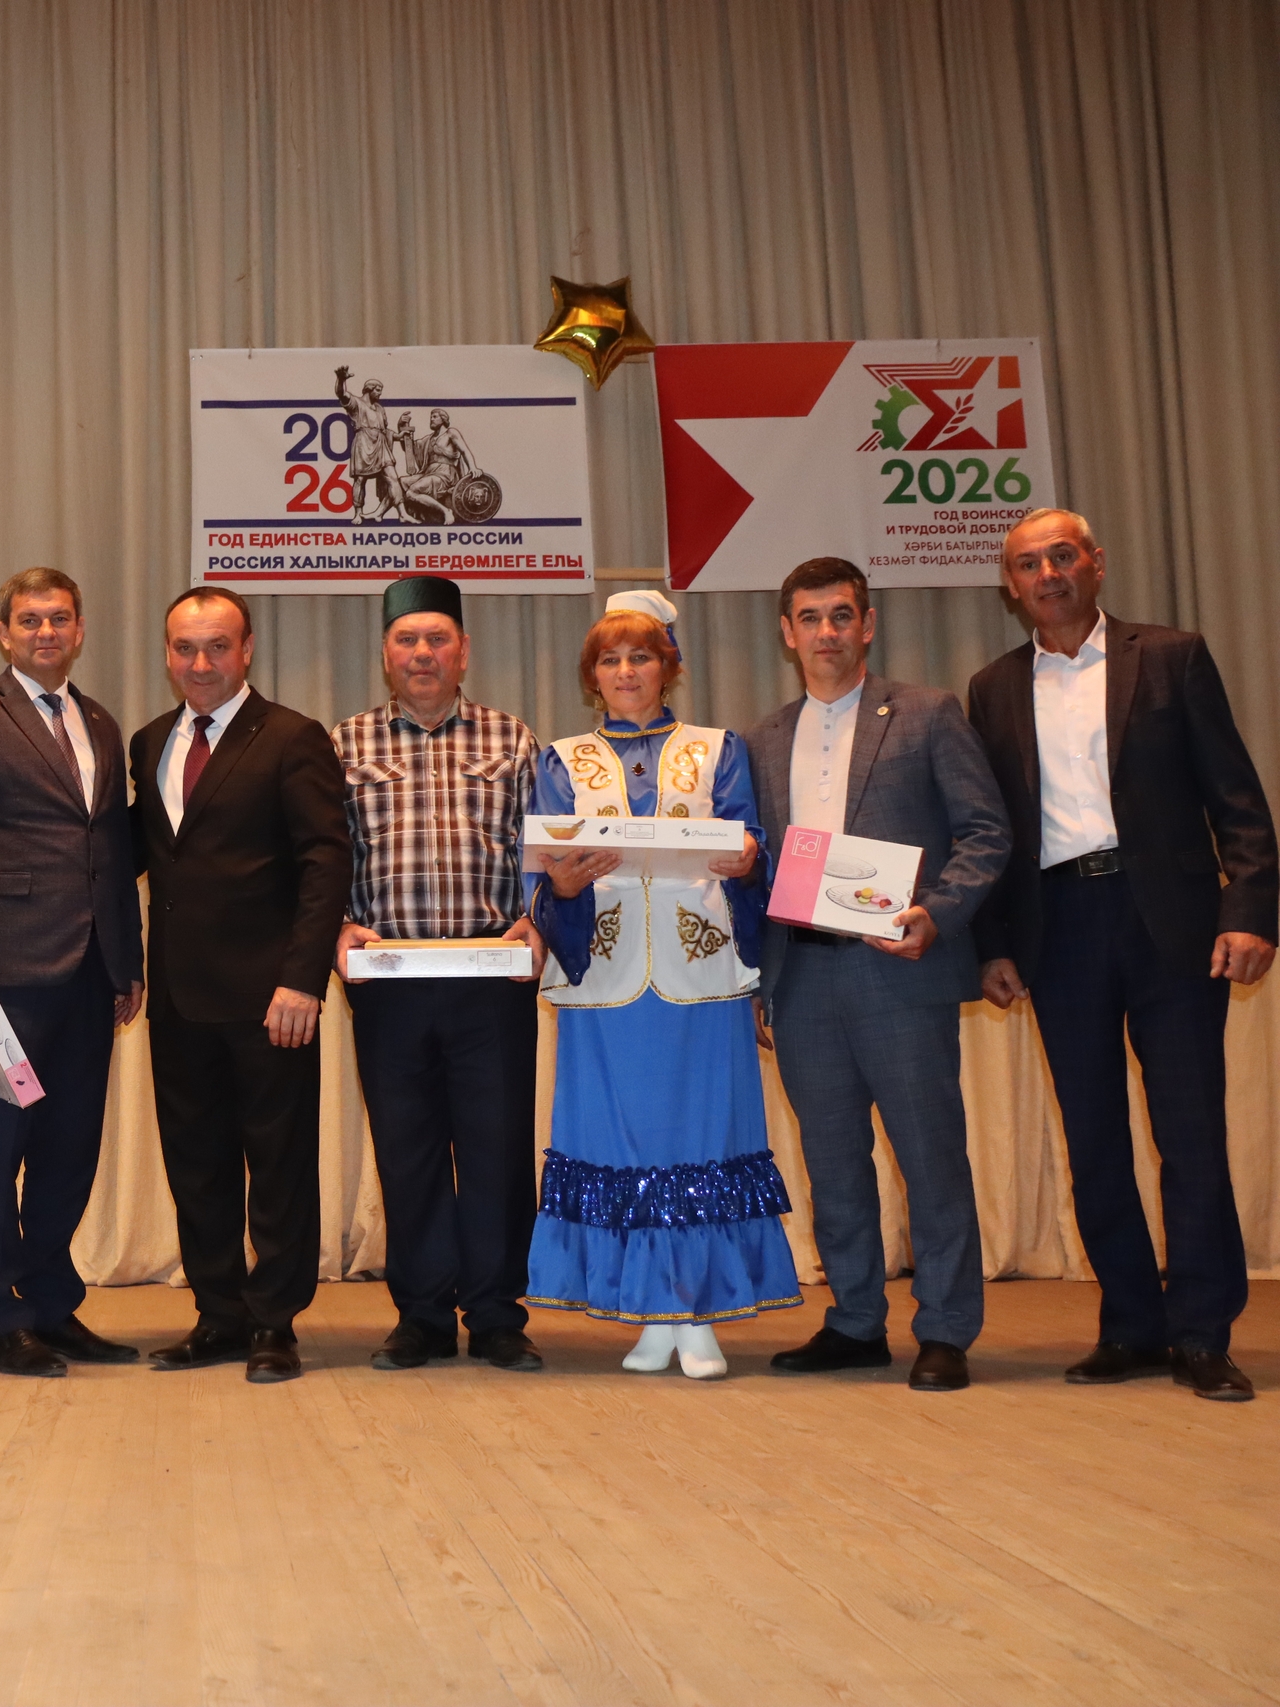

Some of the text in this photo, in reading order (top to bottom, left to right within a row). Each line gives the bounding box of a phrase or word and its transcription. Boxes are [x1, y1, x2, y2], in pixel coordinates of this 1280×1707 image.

[283, 412, 355, 462] 20
[284, 464, 353, 513] 26
[880, 457, 1032, 504] 2026
[934, 510, 959, 522] ГОД
[886, 522, 1011, 535] И ТРУДОВОЙ ДОБЛЕ
[208, 532, 523, 548] ГОД ЕДИНСТВА НАРОДОВ РОССИИ
[904, 541, 942, 551] ХӘРБИ
[208, 554, 583, 570] РОССИЯ ХАЛЫКЛАРЫ БЕРДӘМЛЕГЕ ЕЛЫ
[869, 554, 1004, 566] ХЕЗМӘТ ФИДАКАРЬЛЕ
